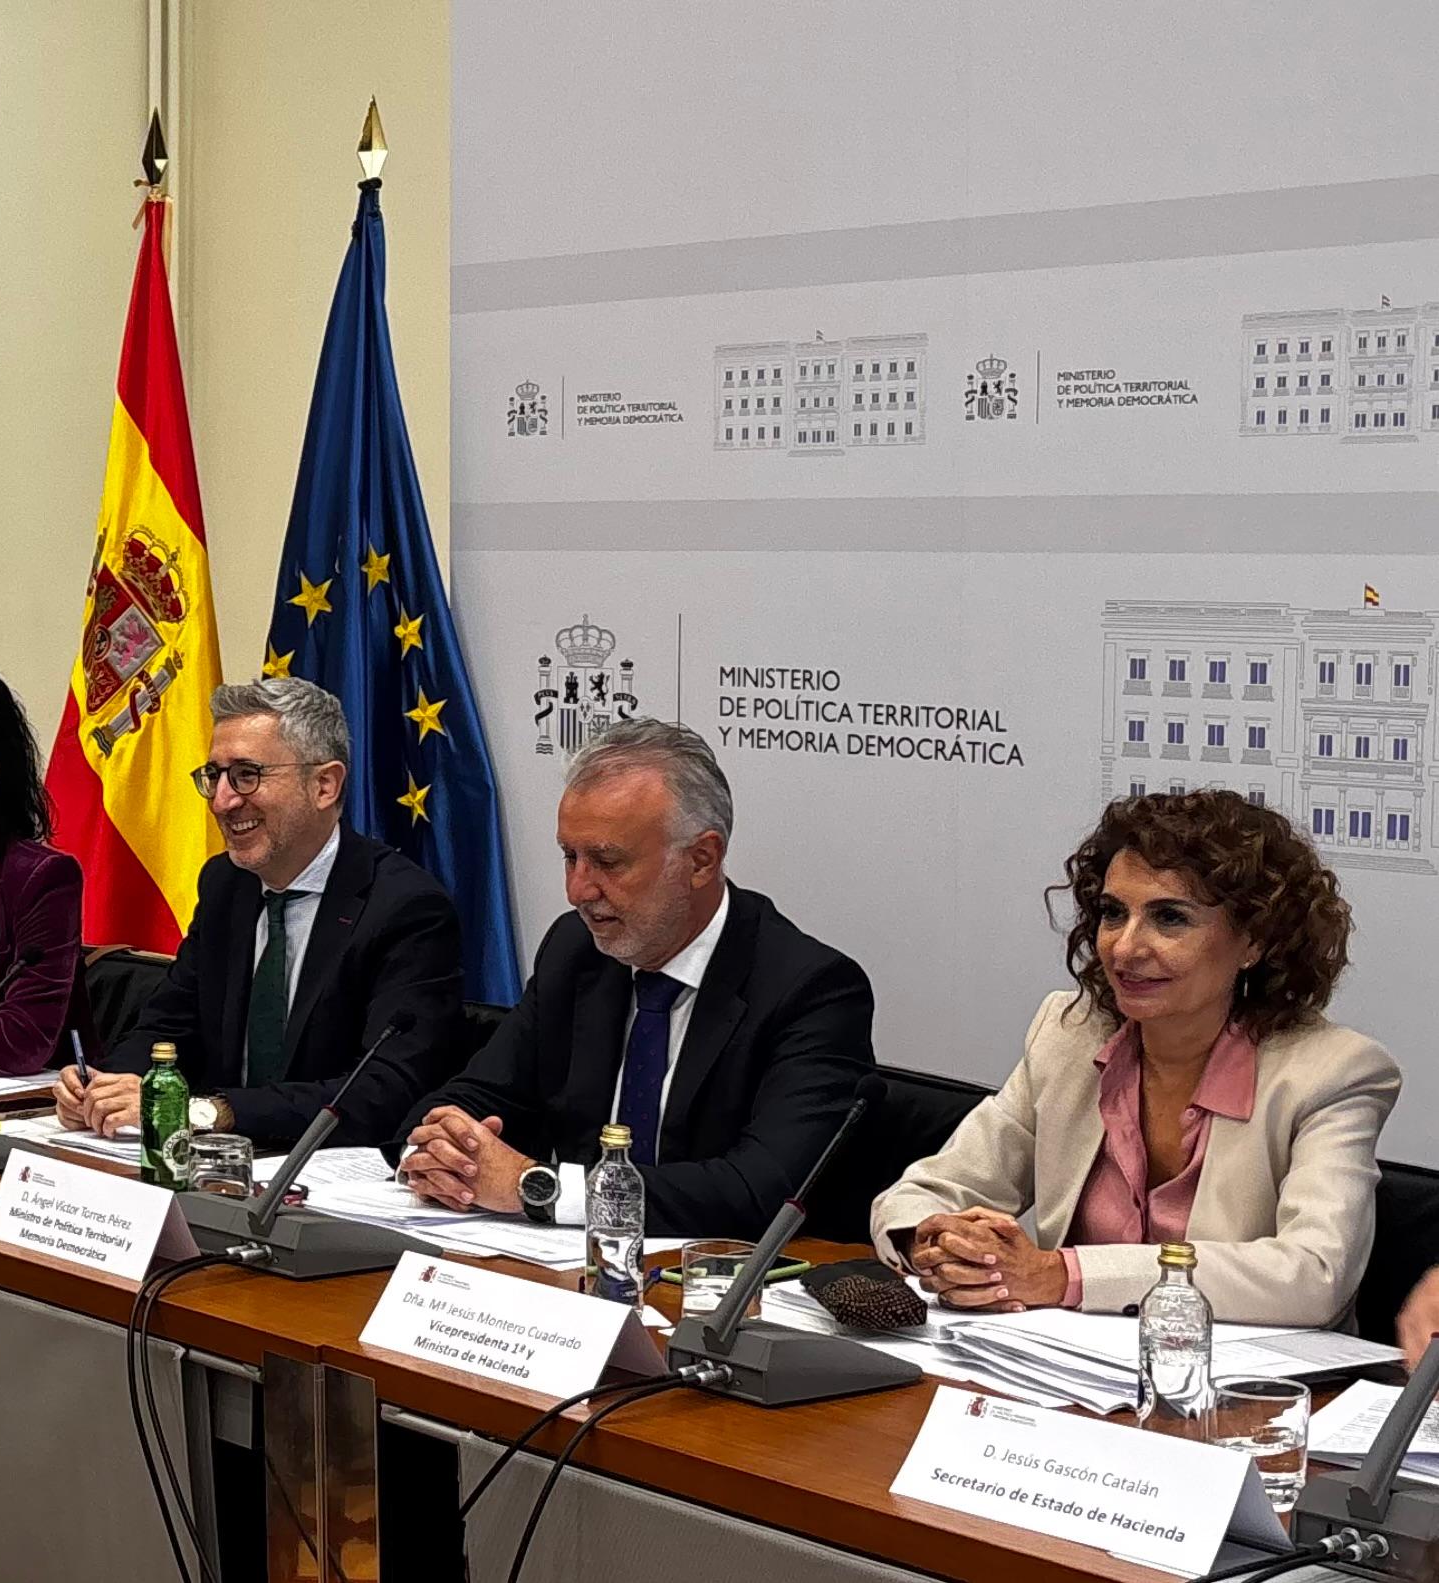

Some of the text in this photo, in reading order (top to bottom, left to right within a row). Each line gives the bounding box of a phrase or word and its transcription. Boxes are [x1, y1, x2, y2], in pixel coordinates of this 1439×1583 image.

[1057, 369, 1115, 381] MINISTERIO
[1057, 380, 1190, 395] DE POLÍTICA TERRITORIAL
[1057, 393, 1198, 408] Y MEMORIA DEMOCRÁTICA
[720, 666, 840, 691] MINISTERIO
[720, 695, 1007, 732] DE POLÍTICA TERRITORIAL
[719, 727, 1024, 766] Y MEMORIA DEMOCRÁTICA
[9, 1207, 132, 1253] Ministro de Política Territorial y
[31, 1192, 54, 1209] Ángel
[55, 1199, 80, 1215] Víctor
[81, 1206, 106, 1224] Torres
[108, 1215, 132, 1230] Pérez
[19, 1228, 106, 1262] Memoria Democrática
[429, 1320, 509, 1351] Vicepresidenta
[526, 1349, 535, 1360] y
[447, 1304, 475, 1321] Jesús
[477, 1311, 525, 1335] Montero
[528, 1326, 581, 1350] Cuadrado
[413, 1336, 530, 1379] Ministra de Hacienda
[983, 1445, 1159, 1499] D. Jesús Gascón Catalán
[930, 1467, 1185, 1543] Secretario de Estado de Hacienda
